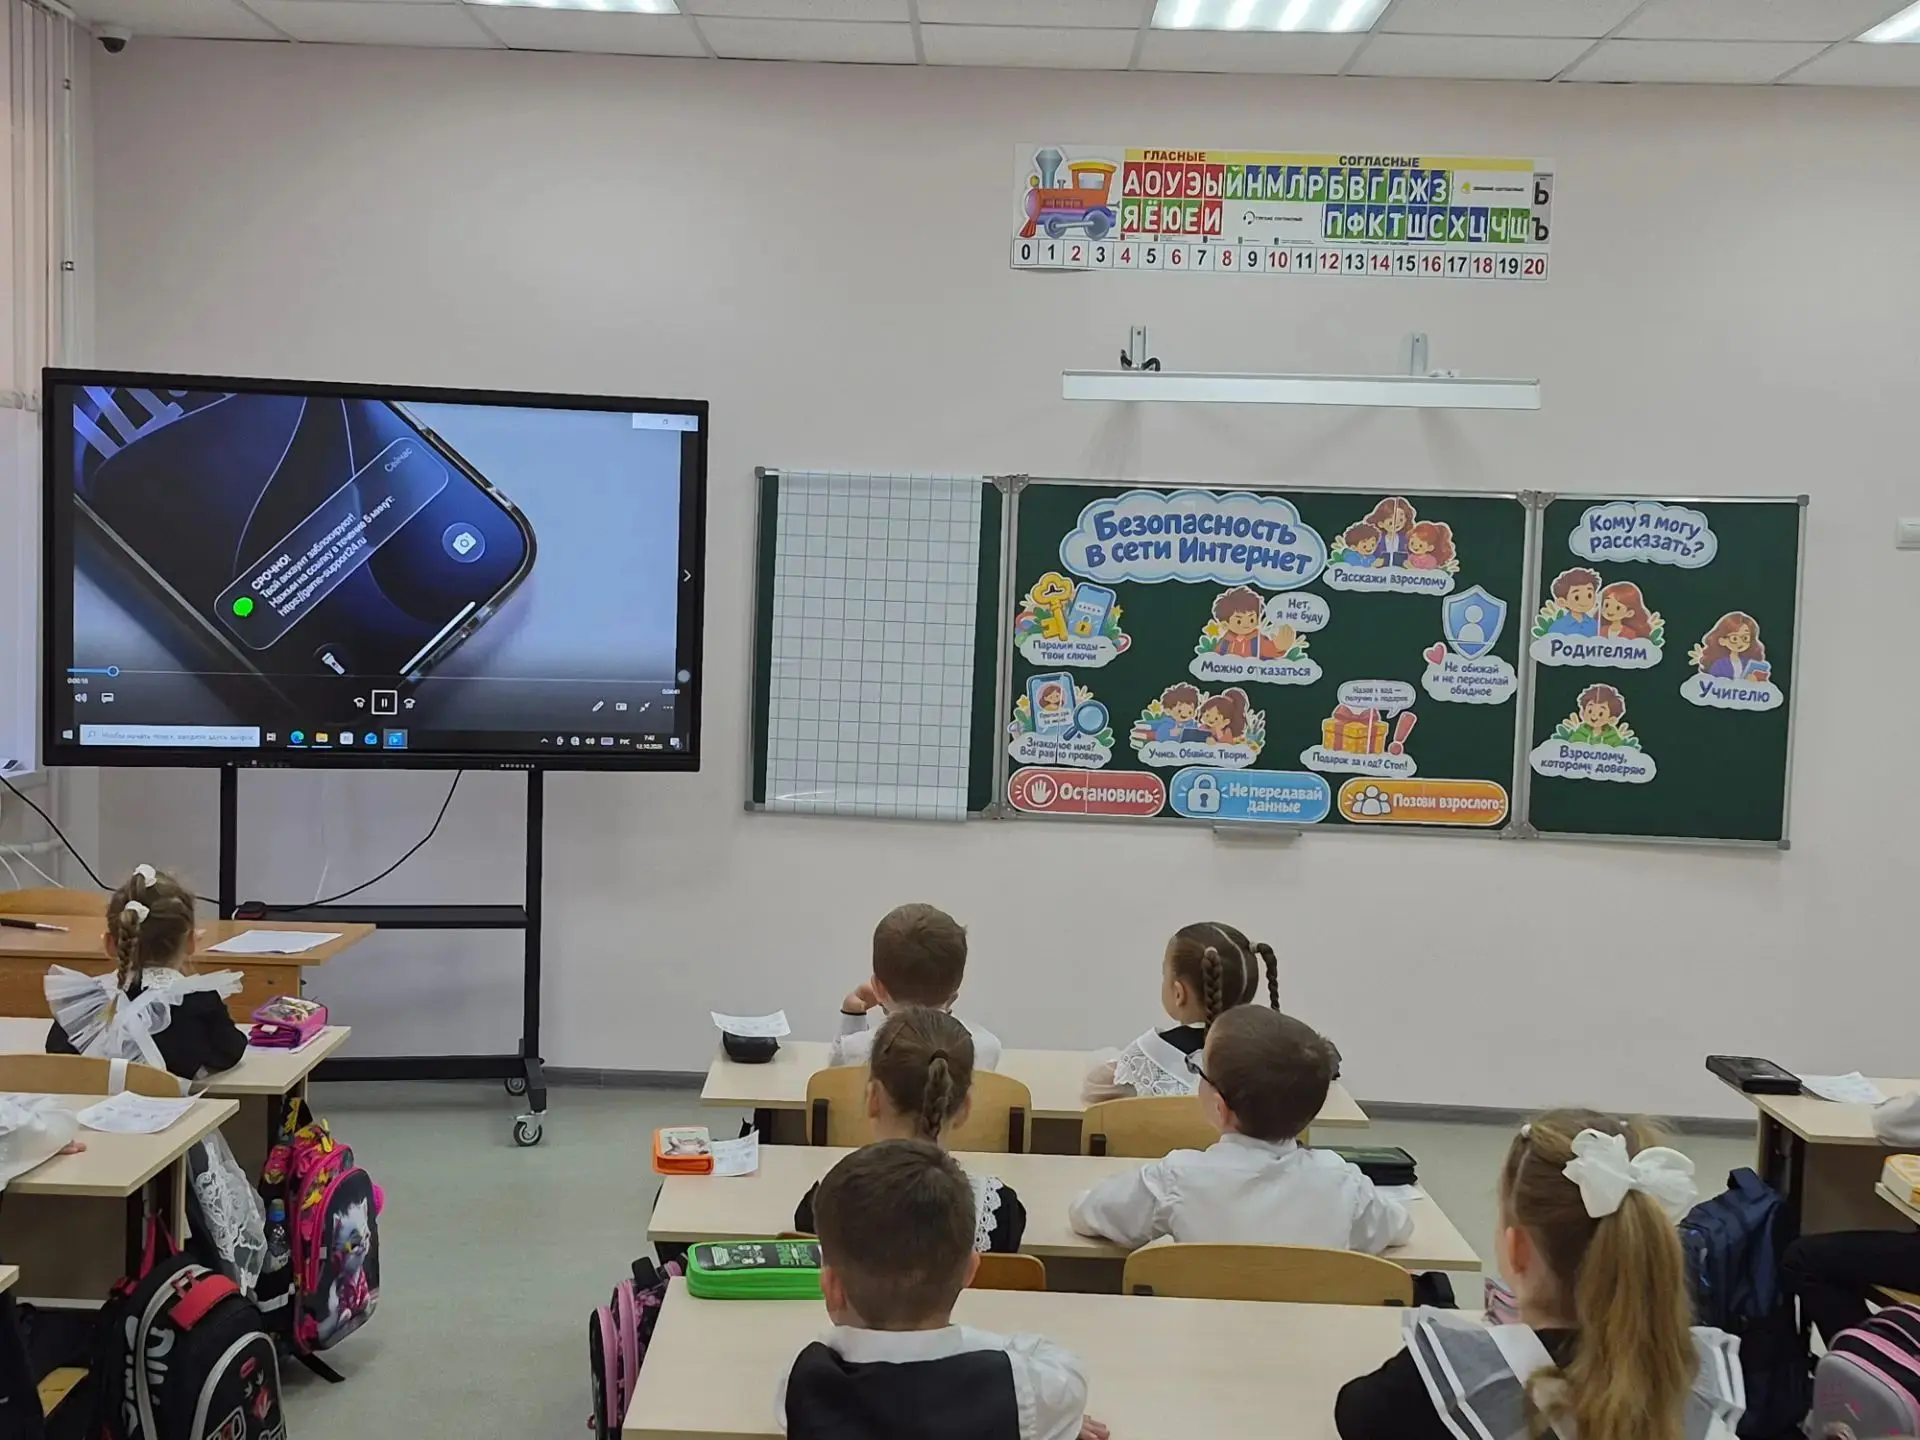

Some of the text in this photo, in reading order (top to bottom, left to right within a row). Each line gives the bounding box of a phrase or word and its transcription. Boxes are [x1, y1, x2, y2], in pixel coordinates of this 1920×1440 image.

[1143, 151, 1206, 161] ГЛАСНЫЕ
[1339, 155, 1420, 167] СОГЛАСНЫЕ
[1021, 244, 1544, 275] 0 1 2 3 4 5 6 7 8 9 10 11 12 13 14 15 16 17 18 19 20
[1094, 510, 1297, 545] Безопасность
[1589, 514, 1636, 533] Кому
[1654, 517, 1701, 540] могу
[307, 551, 333, 575] ссылку
[363, 514, 372, 523] 5
[1590, 534, 1704, 558] рассказать?
[1111, 540, 1171, 564] сети
[1178, 537, 1312, 574] Интернет
[251, 554, 291, 590] СРОЧНО!
[1334, 568, 1447, 589] Расскажи взрослому
[261, 580, 280, 598] Твой
[1288, 598, 1311, 610] Нет,
[1277, 611, 1323, 625] я не буду
[1042, 652, 1064, 660] твои
[1551, 639, 1647, 660] Родителям
[1201, 661, 1243, 674] Можно
[1445, 662, 1499, 674] Не обижай
[1457, 676, 1508, 686] пересылай
[1450, 686, 1492, 696] обидное
[1699, 680, 1770, 703] Учителю
[1074, 742, 1096, 751] имя?
[1218, 748, 1249, 761] Твори.
[1560, 745, 1627, 764] Взрослому,
[1069, 752, 1103, 762] проверь
[1313, 752, 1348, 765] Подарок
[1384, 760, 1407, 769] Стоп!
[1595, 764, 1645, 776] доверяю
[1060, 783, 1153, 803] Остановись
[1229, 782, 1323, 801] Не передавай
[1247, 800, 1301, 814] данные
[1393, 793, 1499, 813] Позови взрослого
